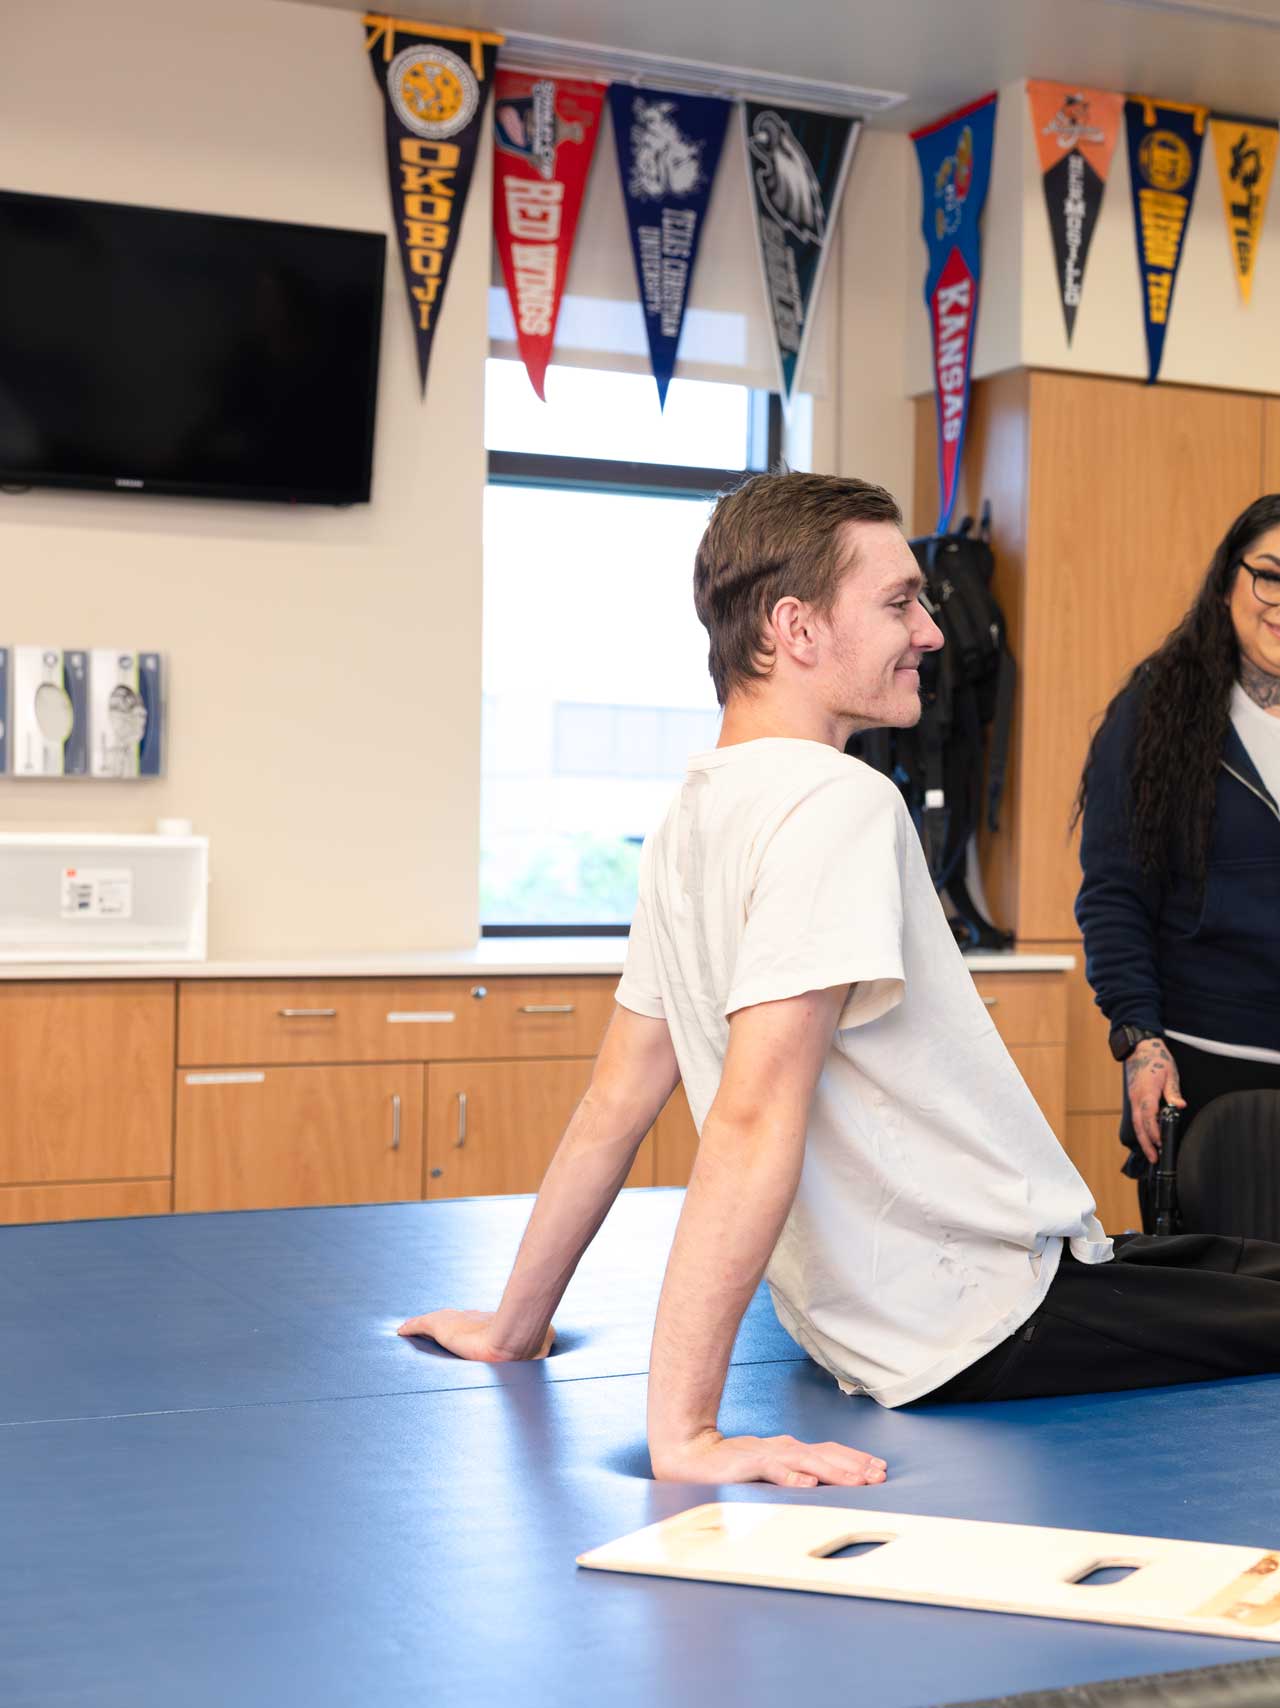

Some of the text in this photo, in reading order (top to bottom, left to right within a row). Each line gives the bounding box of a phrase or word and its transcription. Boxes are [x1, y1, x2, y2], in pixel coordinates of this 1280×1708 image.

[400, 138, 461, 329] OKOBOJI
[504, 175, 564, 335] RED WINGS
[662, 208, 698, 257] TEXAS
[937, 279, 972, 442] KANSAS
